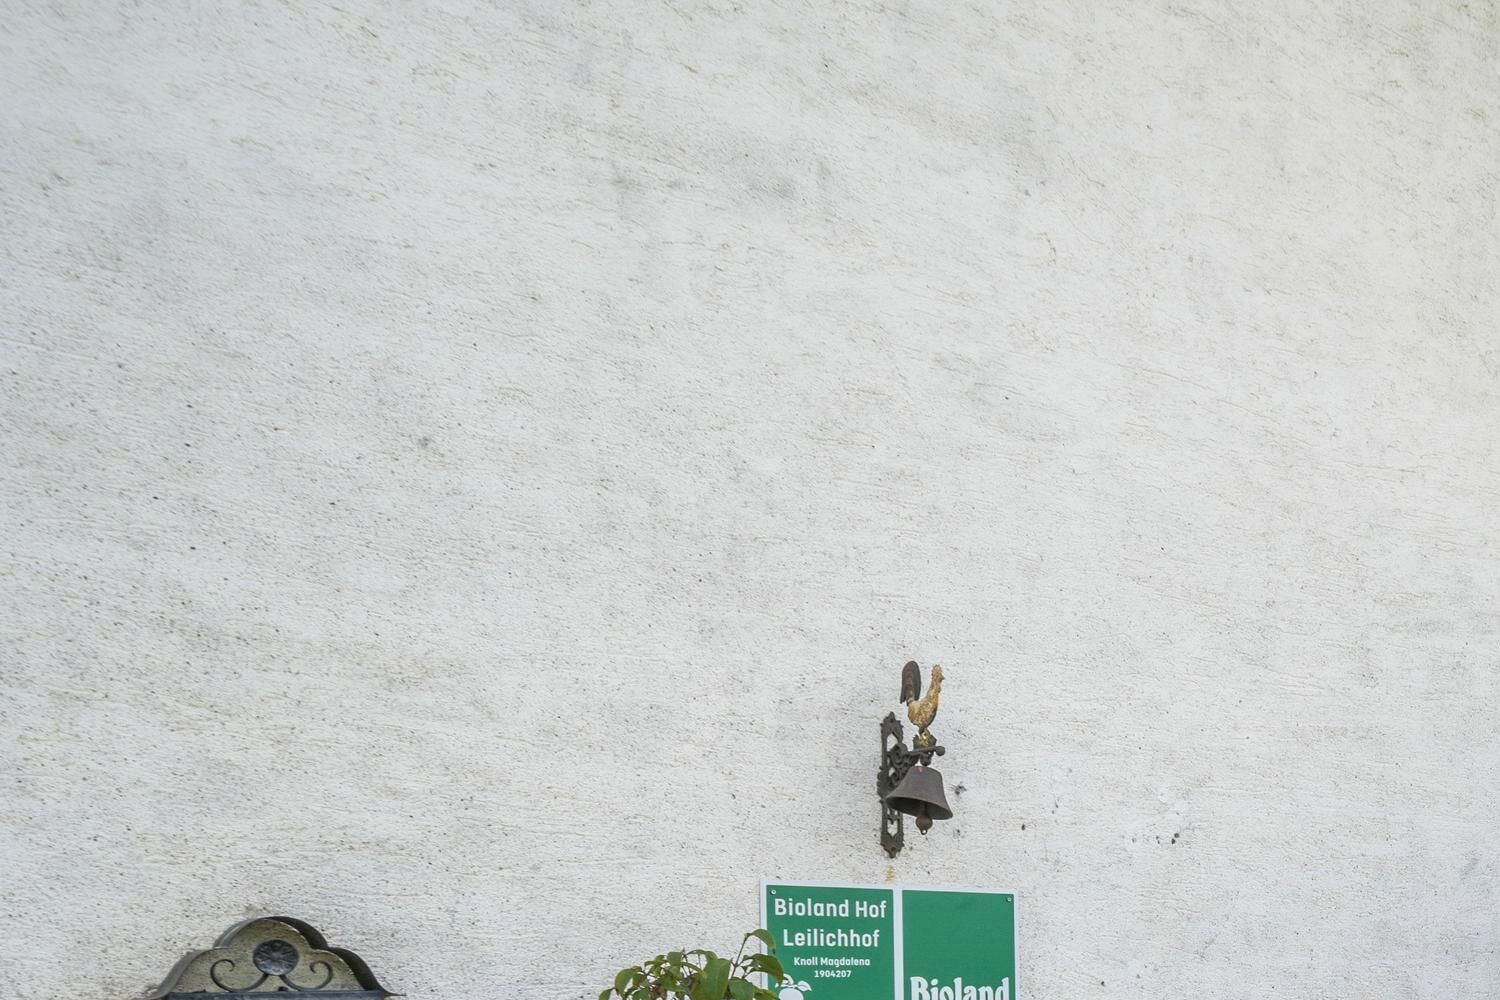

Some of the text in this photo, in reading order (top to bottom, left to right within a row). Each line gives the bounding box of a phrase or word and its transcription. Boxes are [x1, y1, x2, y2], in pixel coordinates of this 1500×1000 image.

[774, 898, 887, 918] Bioland Hof
[783, 928, 880, 947] Leilichhof
[793, 957, 870, 968] Knoll Magdalena
[814, 970, 852, 978] 1904207
